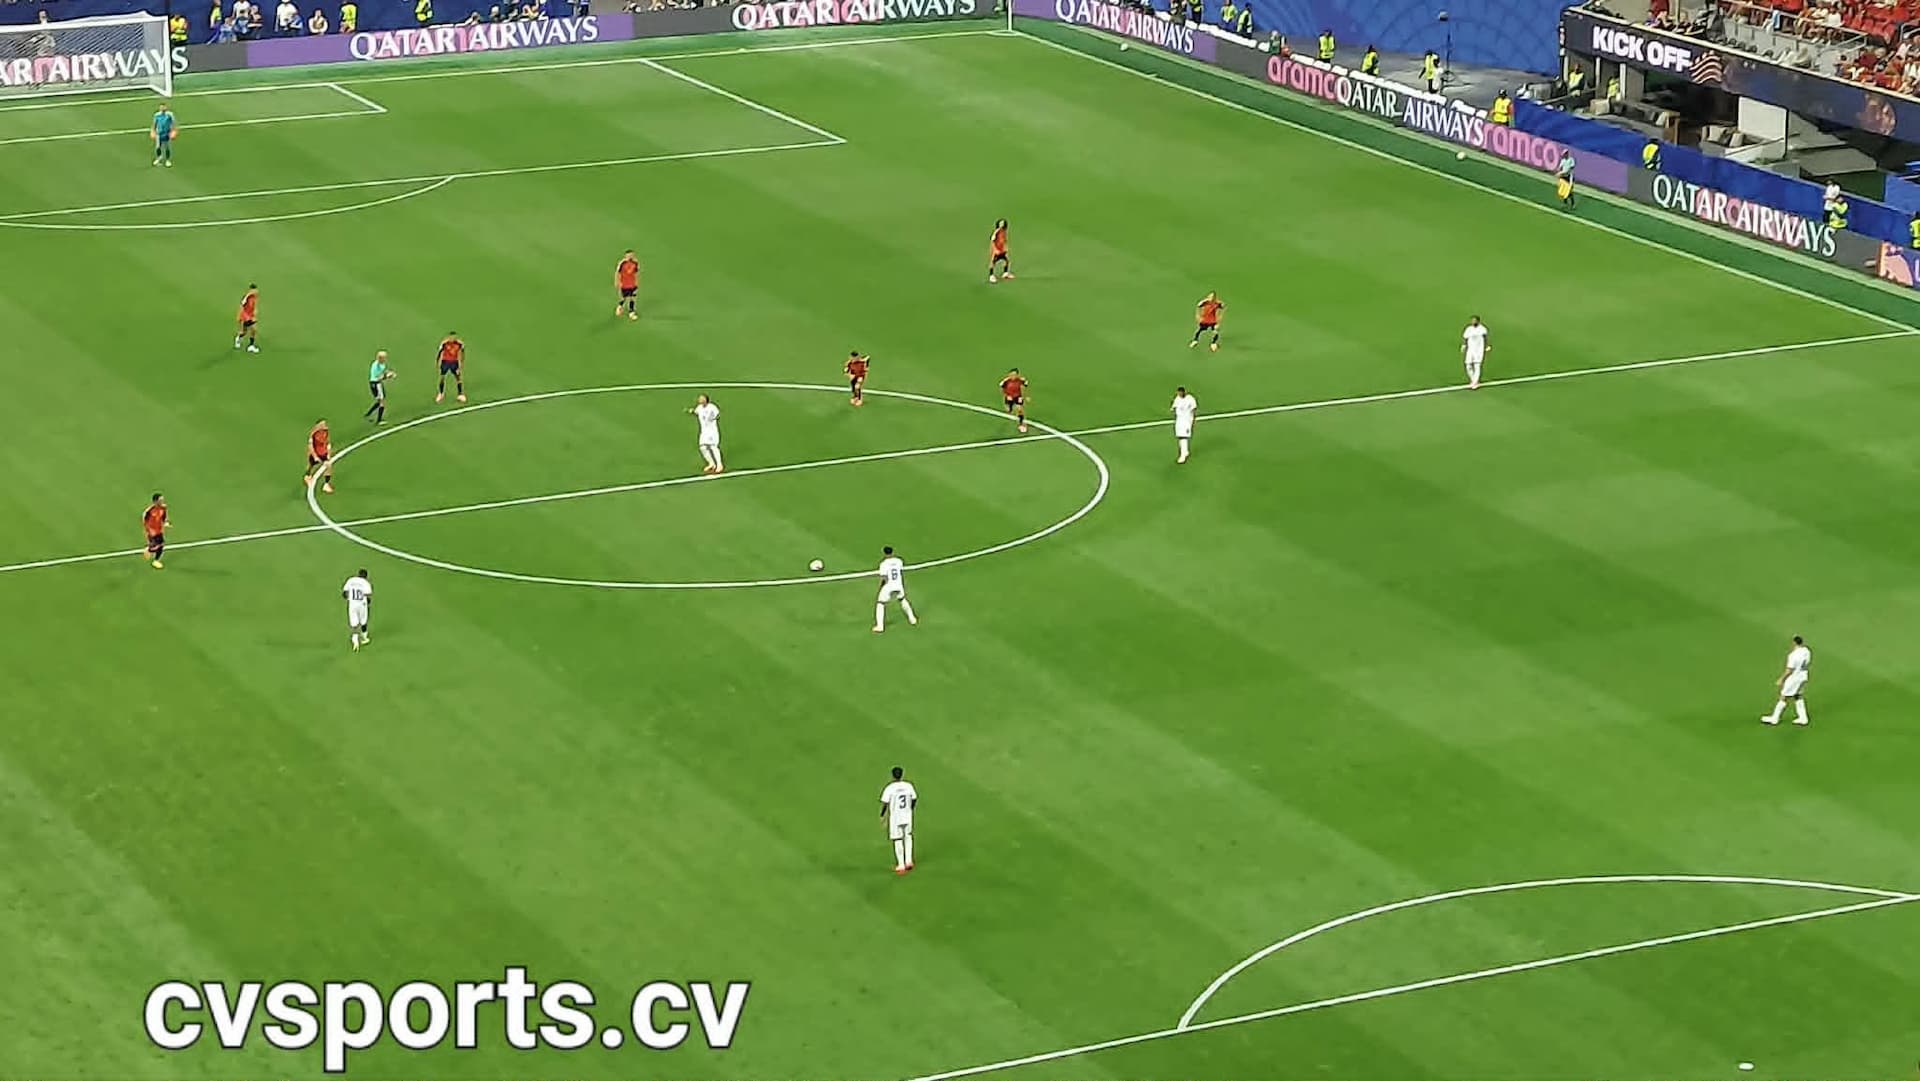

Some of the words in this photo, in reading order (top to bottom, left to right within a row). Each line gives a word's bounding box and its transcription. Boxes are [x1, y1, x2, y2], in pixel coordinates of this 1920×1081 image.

[350, 28, 456, 60] QATAR
[468, 15, 598, 51] AIRWAYS
[732, 0, 836, 30] QATAR
[848, 0, 975, 21] AIRWAYS
[1055, 0, 1120, 32] QATAR
[1126, 11, 1194, 54] AIRWAYS
[50, 46, 188, 81] AIRWAYS
[1593, 26, 1644, 61] KICK
[1647, 41, 1692, 72] OFF
[1335, 76, 1403, 118] QATAR
[1403, 97, 1484, 146] AIRWAYS
[1653, 174, 1728, 224] QATAR
[1735, 201, 1837, 257] AIRWAYS
